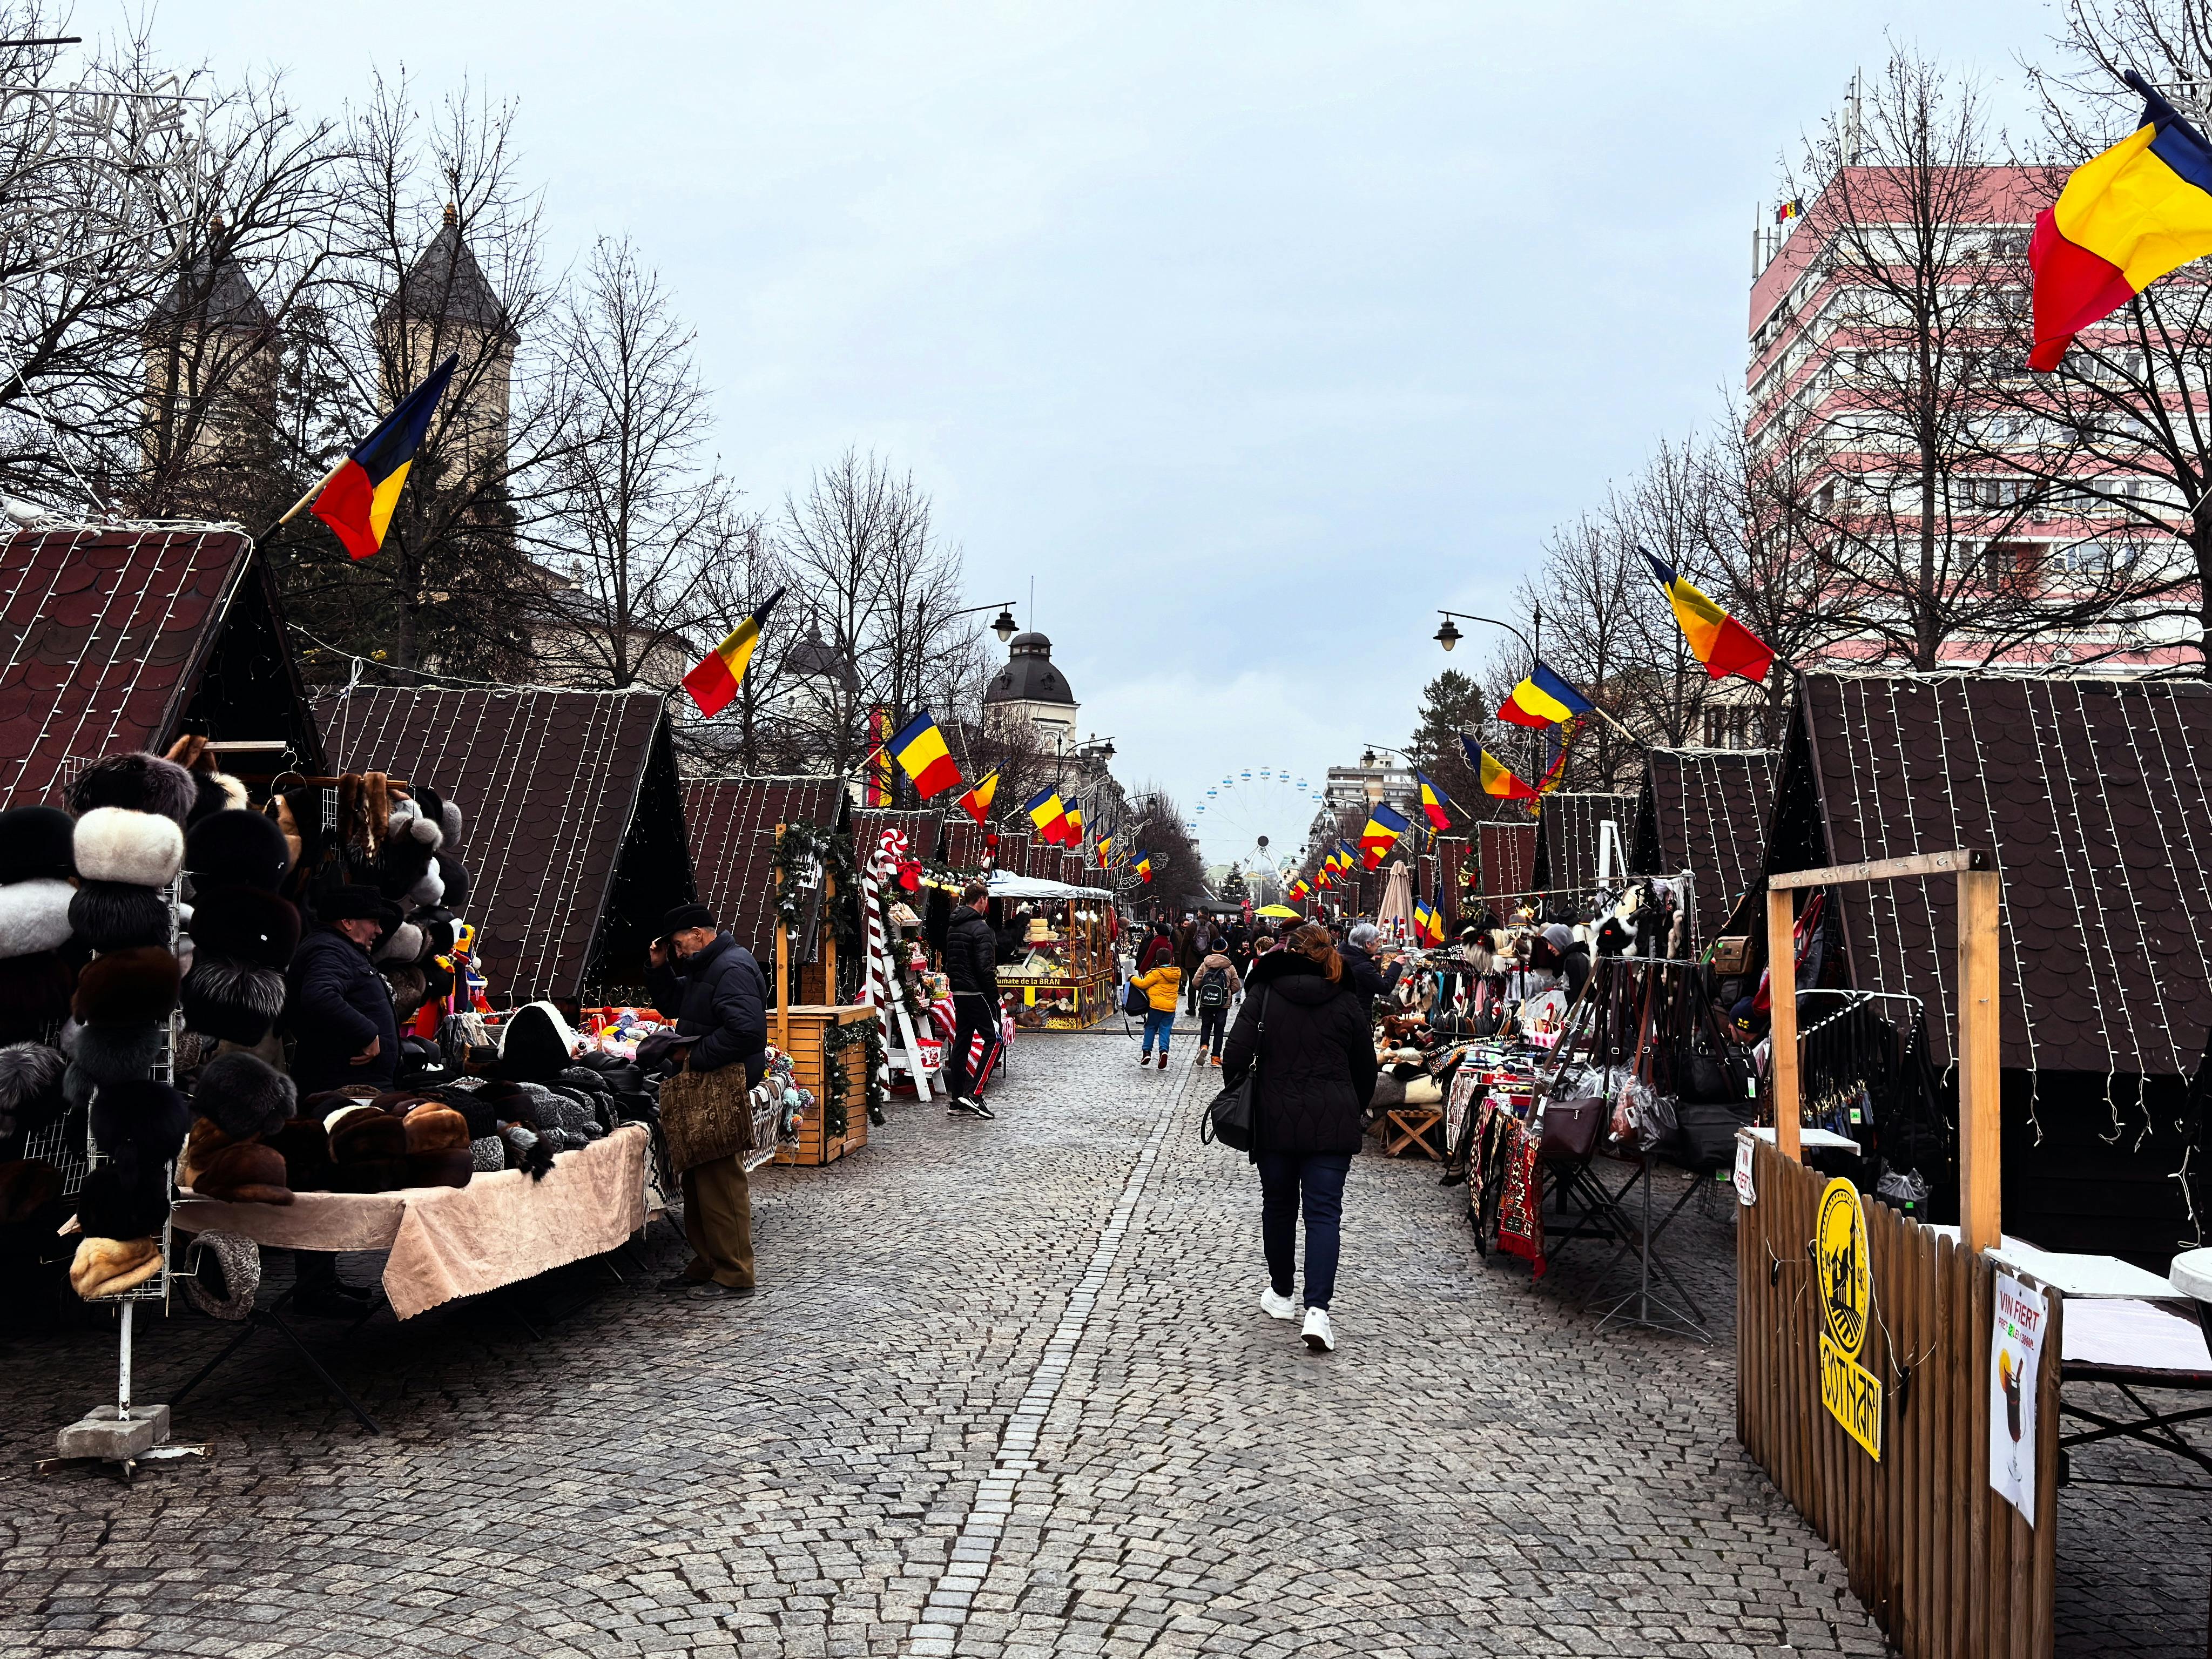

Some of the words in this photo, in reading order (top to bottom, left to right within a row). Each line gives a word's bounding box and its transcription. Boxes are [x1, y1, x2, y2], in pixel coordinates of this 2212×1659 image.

[1738, 1170, 1749, 1191] FIERT
[2000, 1290, 2013, 1317] VIN
[2014, 1300, 2040, 1333] FIERT
[1822, 1343, 1879, 1449] COTNARI
